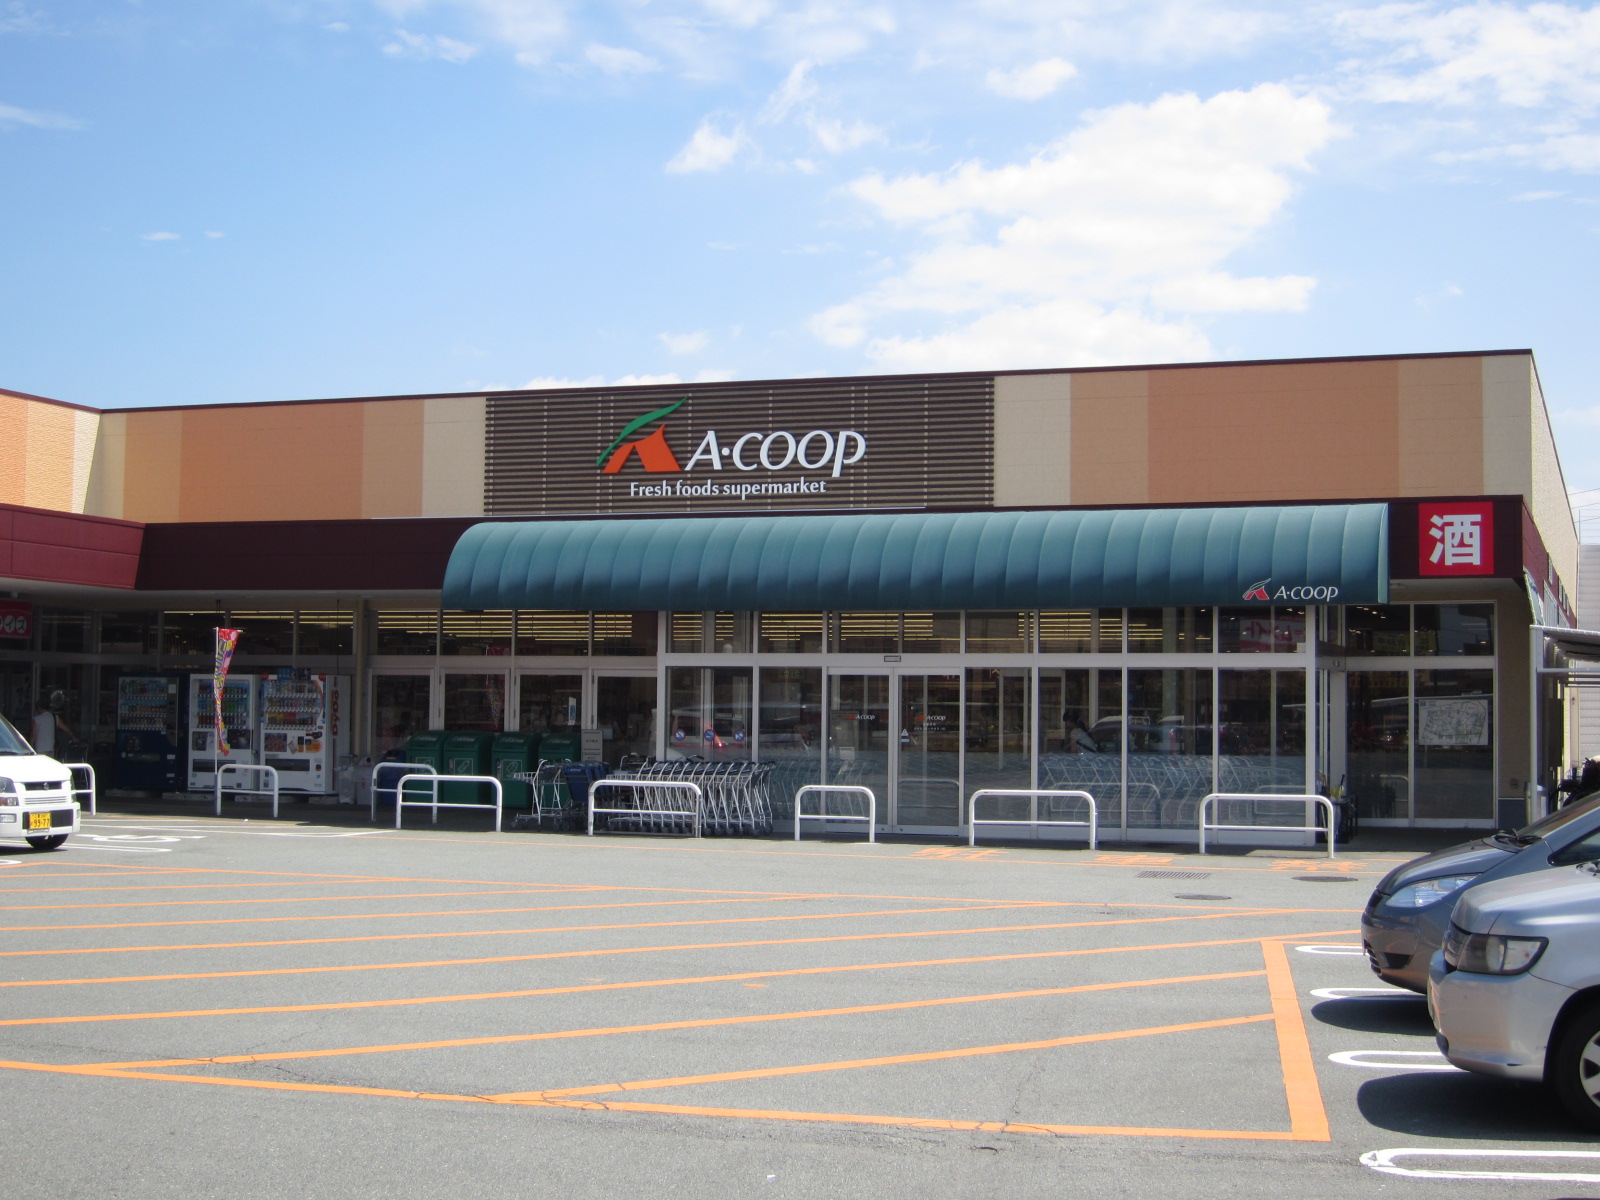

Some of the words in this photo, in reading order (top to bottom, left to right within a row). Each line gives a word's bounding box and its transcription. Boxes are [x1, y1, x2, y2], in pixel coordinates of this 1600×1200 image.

[630, 480, 673, 497] Fresh
[676, 479, 719, 496] foods
[722, 477, 827, 500] supermarket
[1428, 513, 1482, 566] 酒
